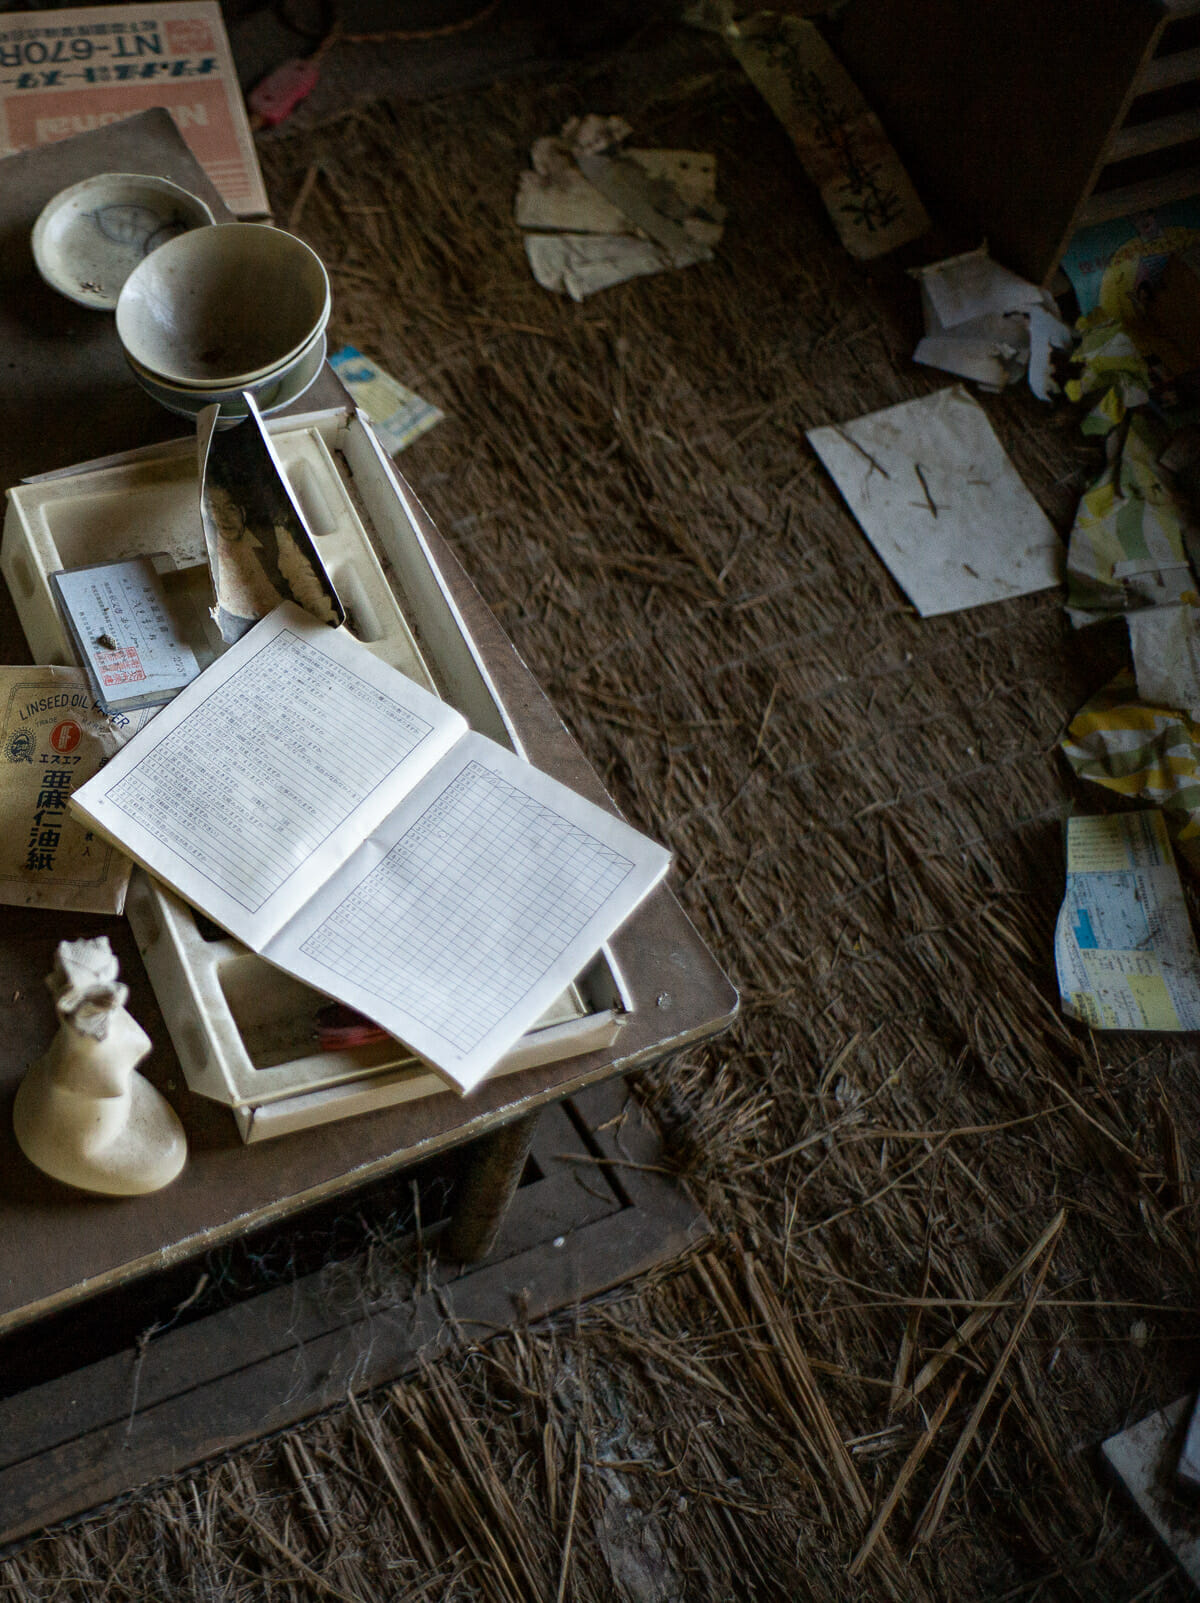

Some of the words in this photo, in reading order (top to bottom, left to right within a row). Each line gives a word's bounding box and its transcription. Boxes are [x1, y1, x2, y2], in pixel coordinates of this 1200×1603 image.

[19, 693, 69, 721] LINSEED
[71, 694, 89, 709] OIL
[39, 754, 82, 766] エスエフ
[26, 770, 74, 872] 亜麻仁油紙
